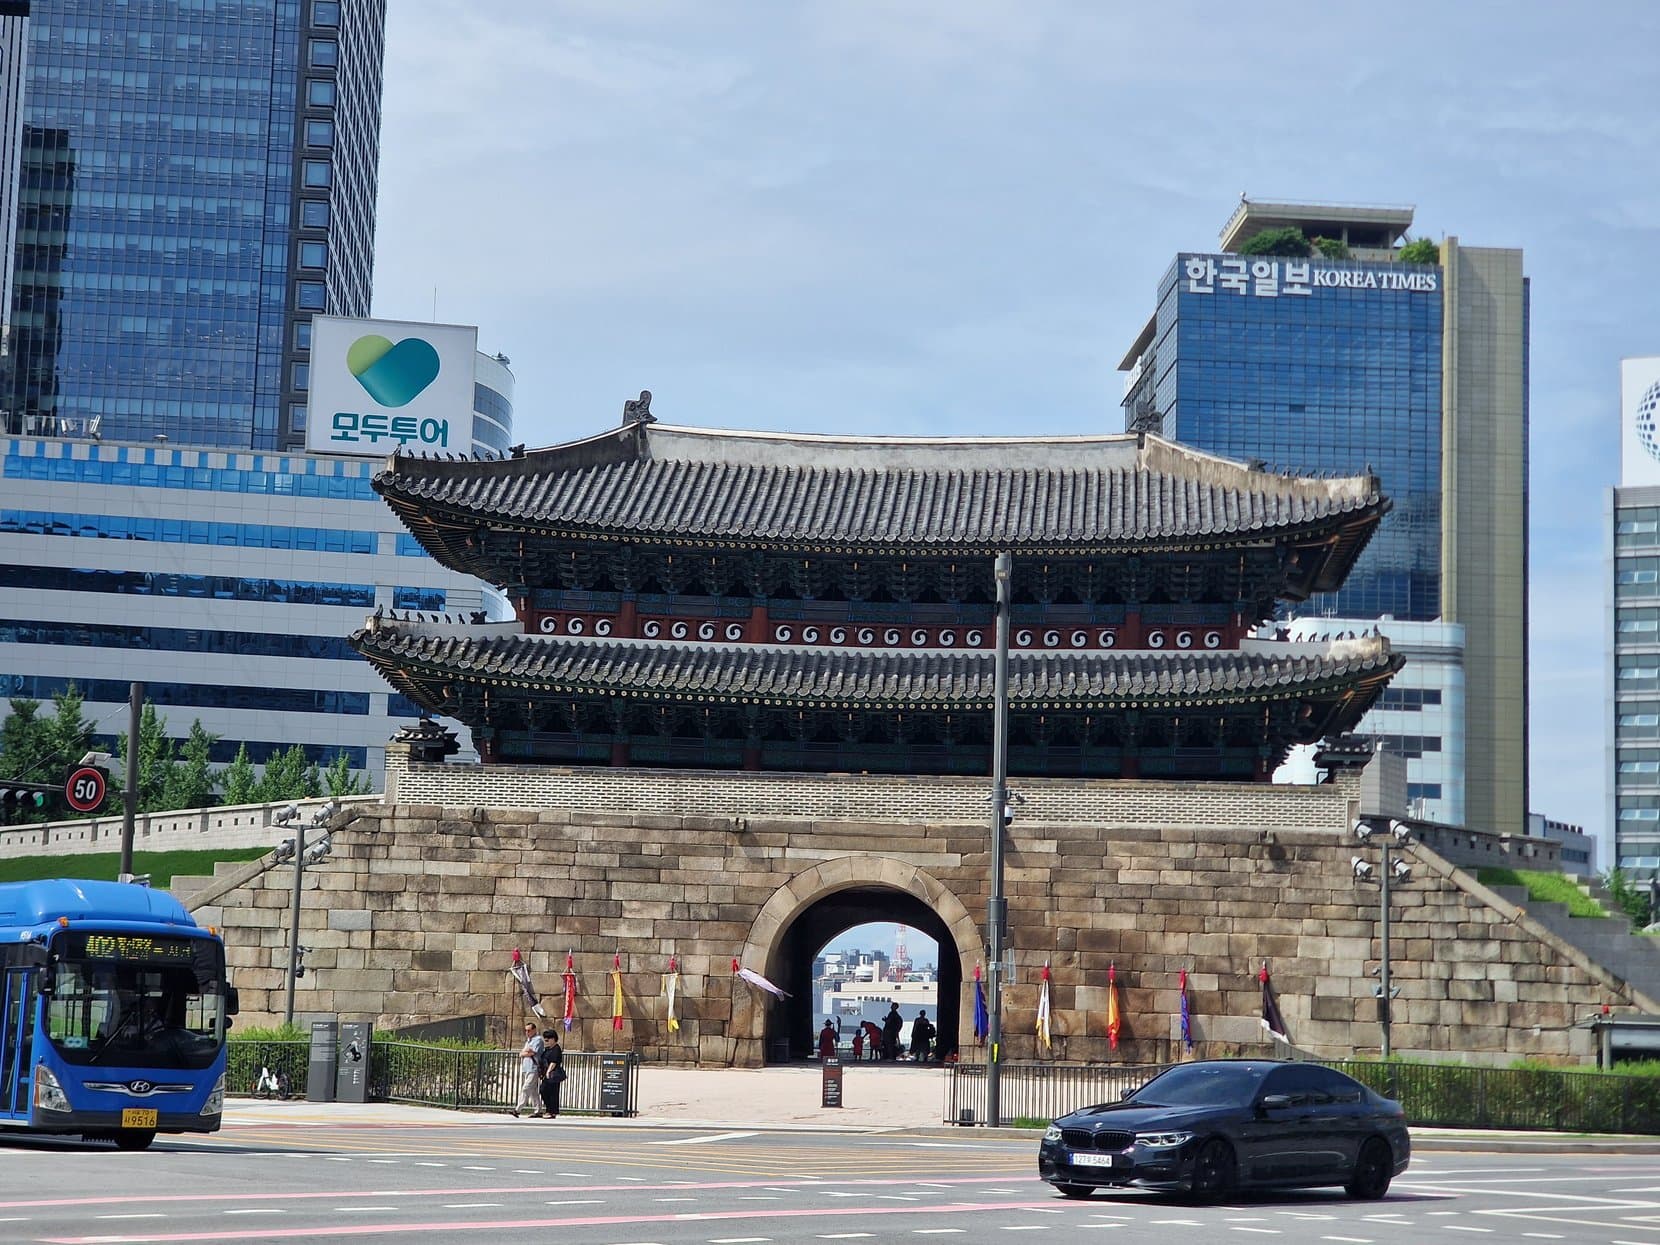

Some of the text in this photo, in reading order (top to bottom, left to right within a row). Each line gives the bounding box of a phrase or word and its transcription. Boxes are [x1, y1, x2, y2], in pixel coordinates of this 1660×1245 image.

[1185, 258, 1313, 297] 한국일보
[1313, 269, 1437, 291] KOREA TIMES
[330, 412, 449, 448] 모두투어
[75, 779, 97, 800] 50
[131, 1115, 155, 1126] 9516
